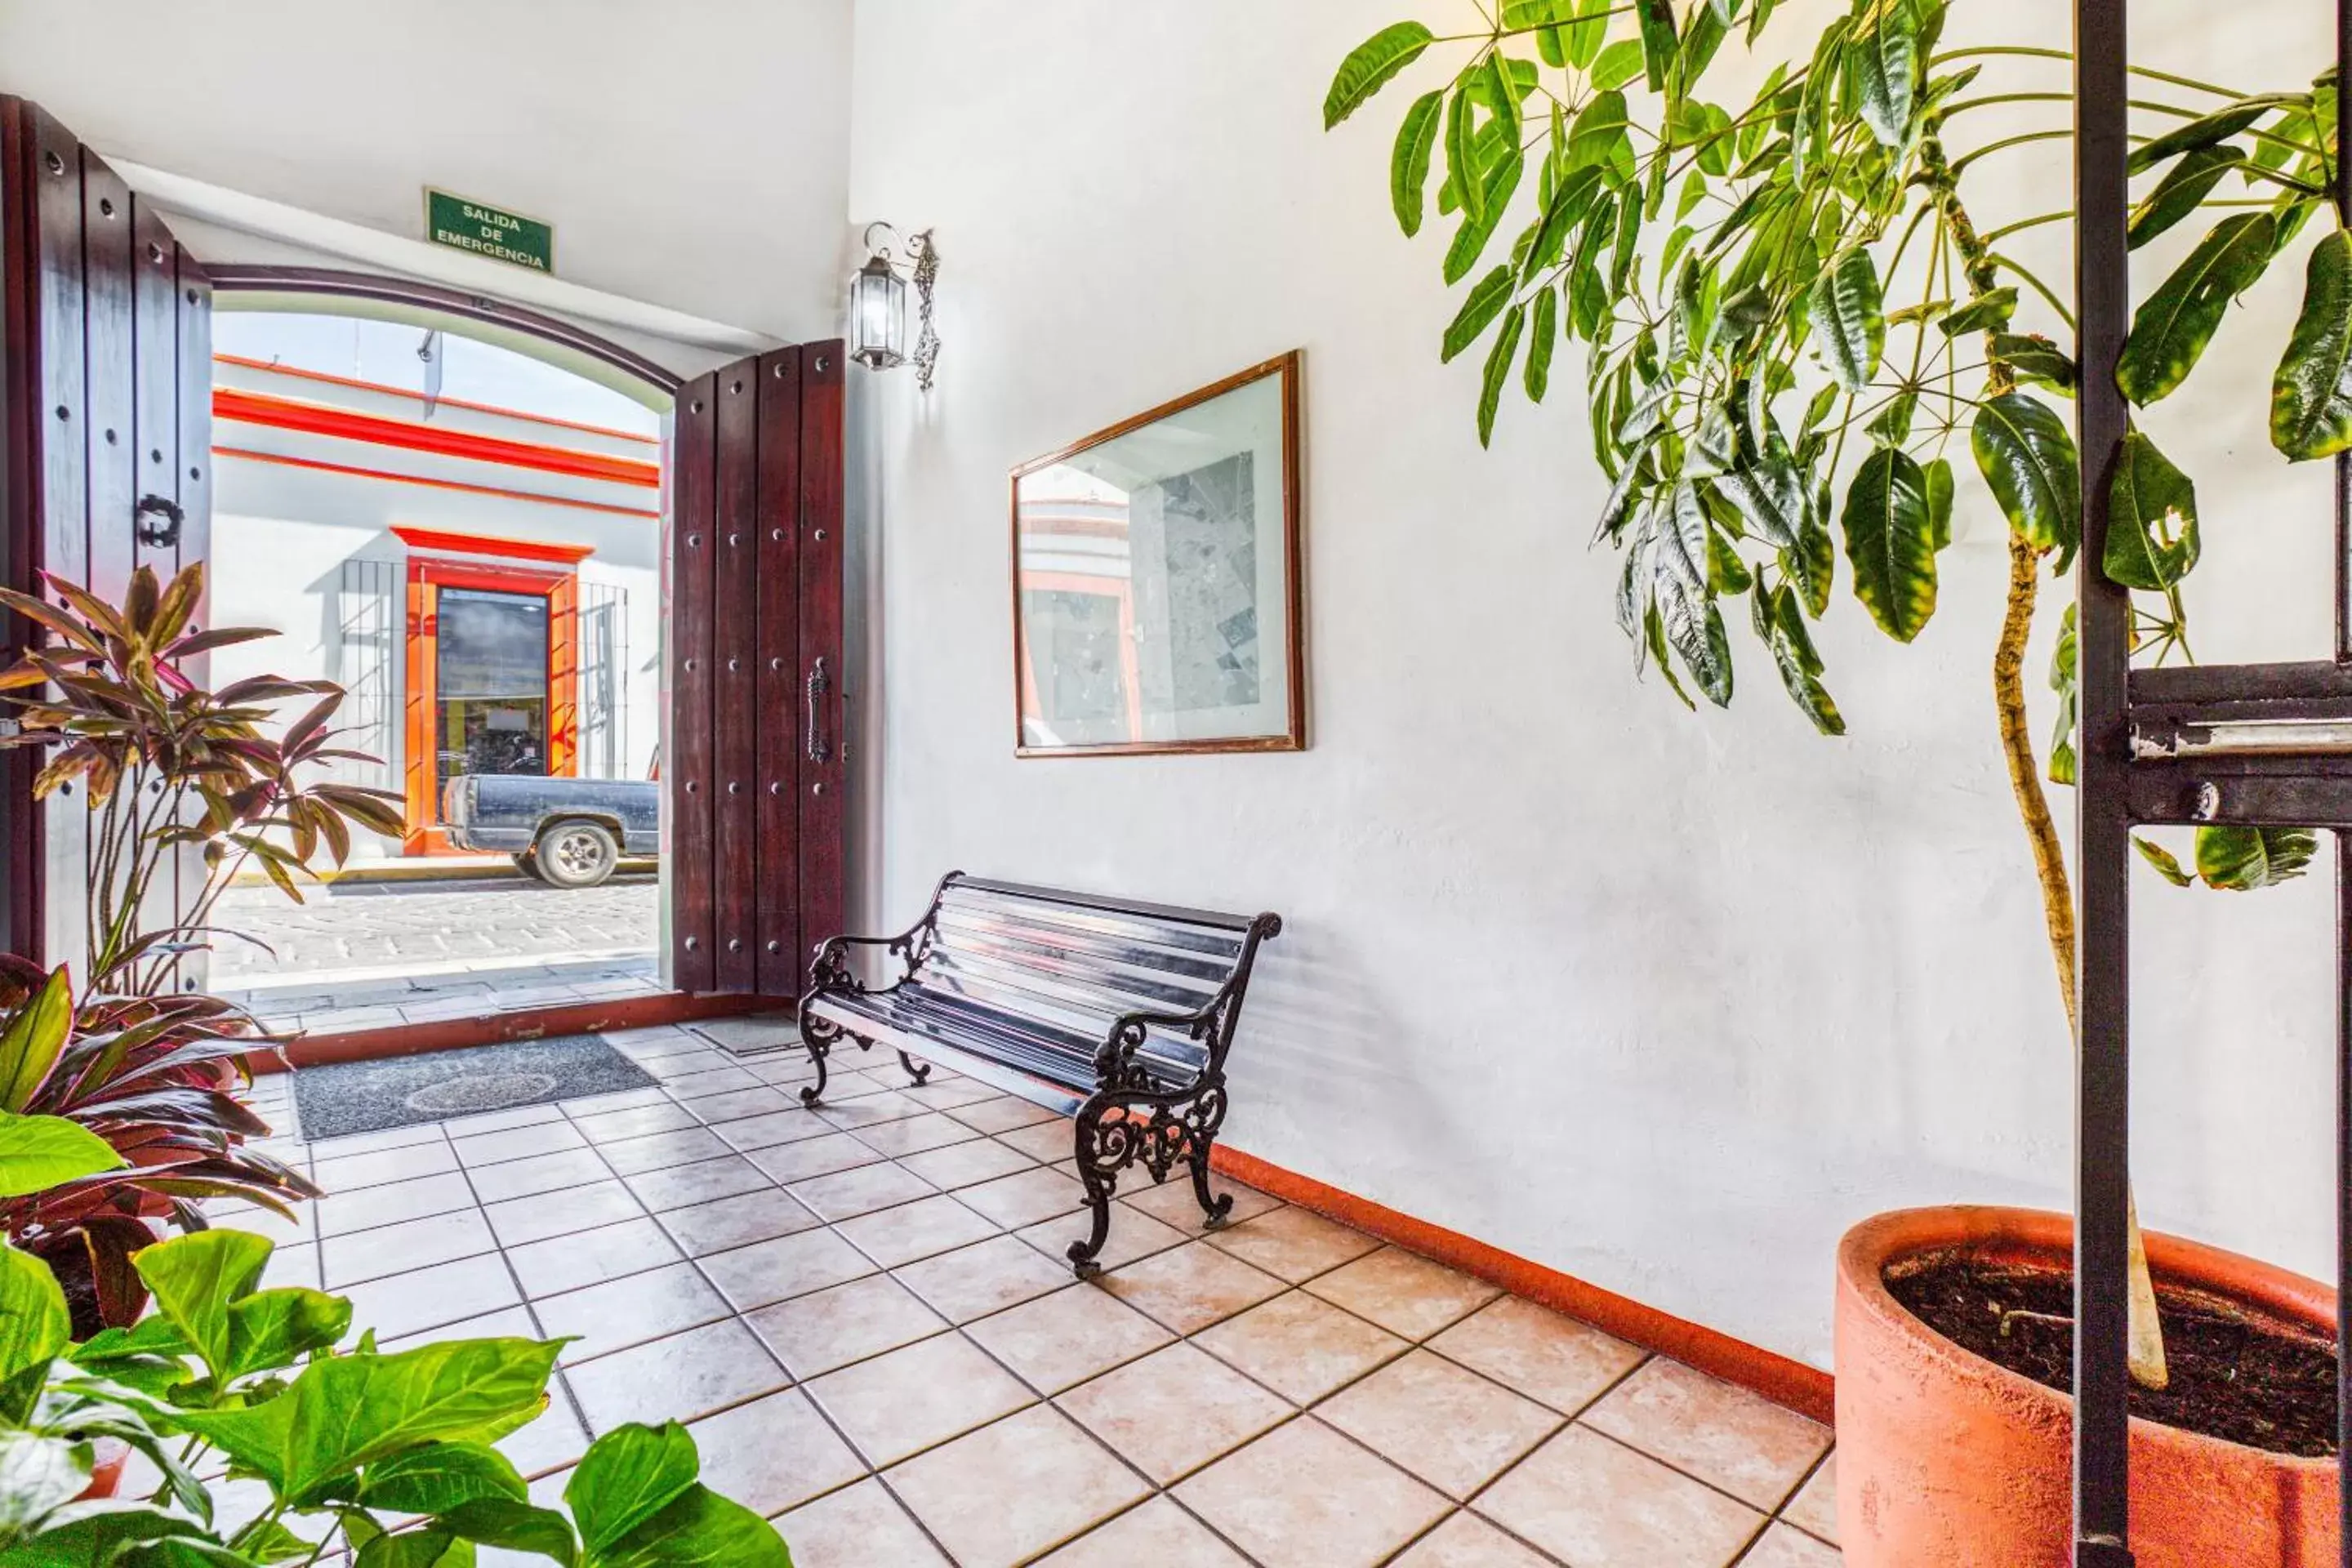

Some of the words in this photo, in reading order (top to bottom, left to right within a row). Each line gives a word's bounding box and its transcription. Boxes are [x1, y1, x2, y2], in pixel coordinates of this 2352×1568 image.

[463, 205, 520, 232] SALIDA
[480, 226, 503, 242] DE
[437, 229, 544, 268] EMERGENCIA
